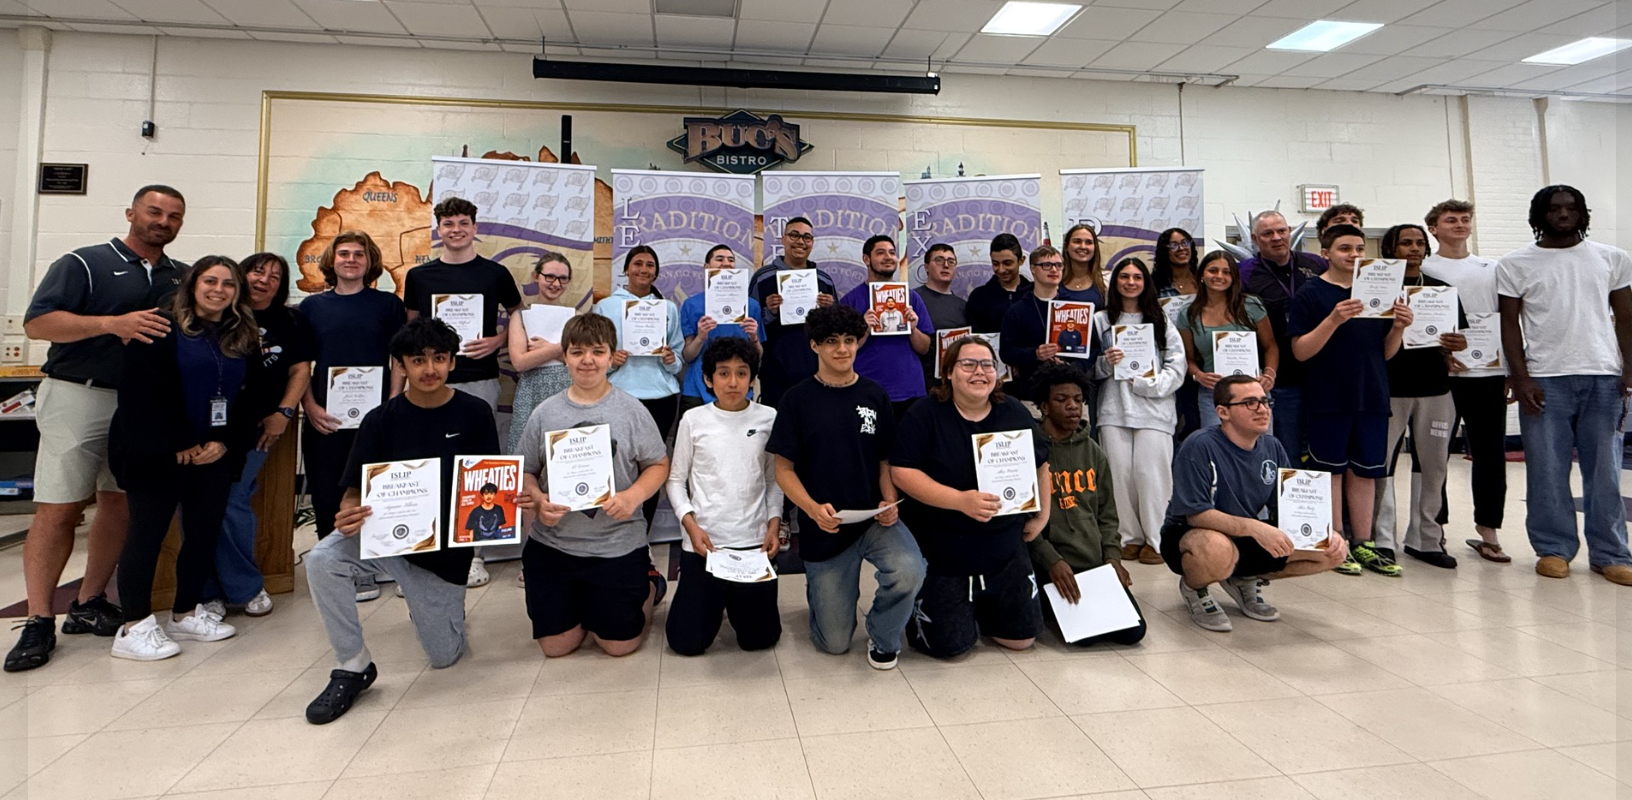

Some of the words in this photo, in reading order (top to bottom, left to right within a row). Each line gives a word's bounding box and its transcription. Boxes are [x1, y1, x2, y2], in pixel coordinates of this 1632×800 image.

[716, 155, 767, 165] BISTRO
[362, 191, 398, 203] QUEENS
[1311, 191, 1332, 207] EXIT
[876, 287, 905, 303] WHEATIES
[1055, 308, 1089, 324] WHEATIES
[569, 436, 587, 444] ISLIP
[390, 471, 412, 479] ISLIP
[464, 465, 517, 491] WHEATIES
